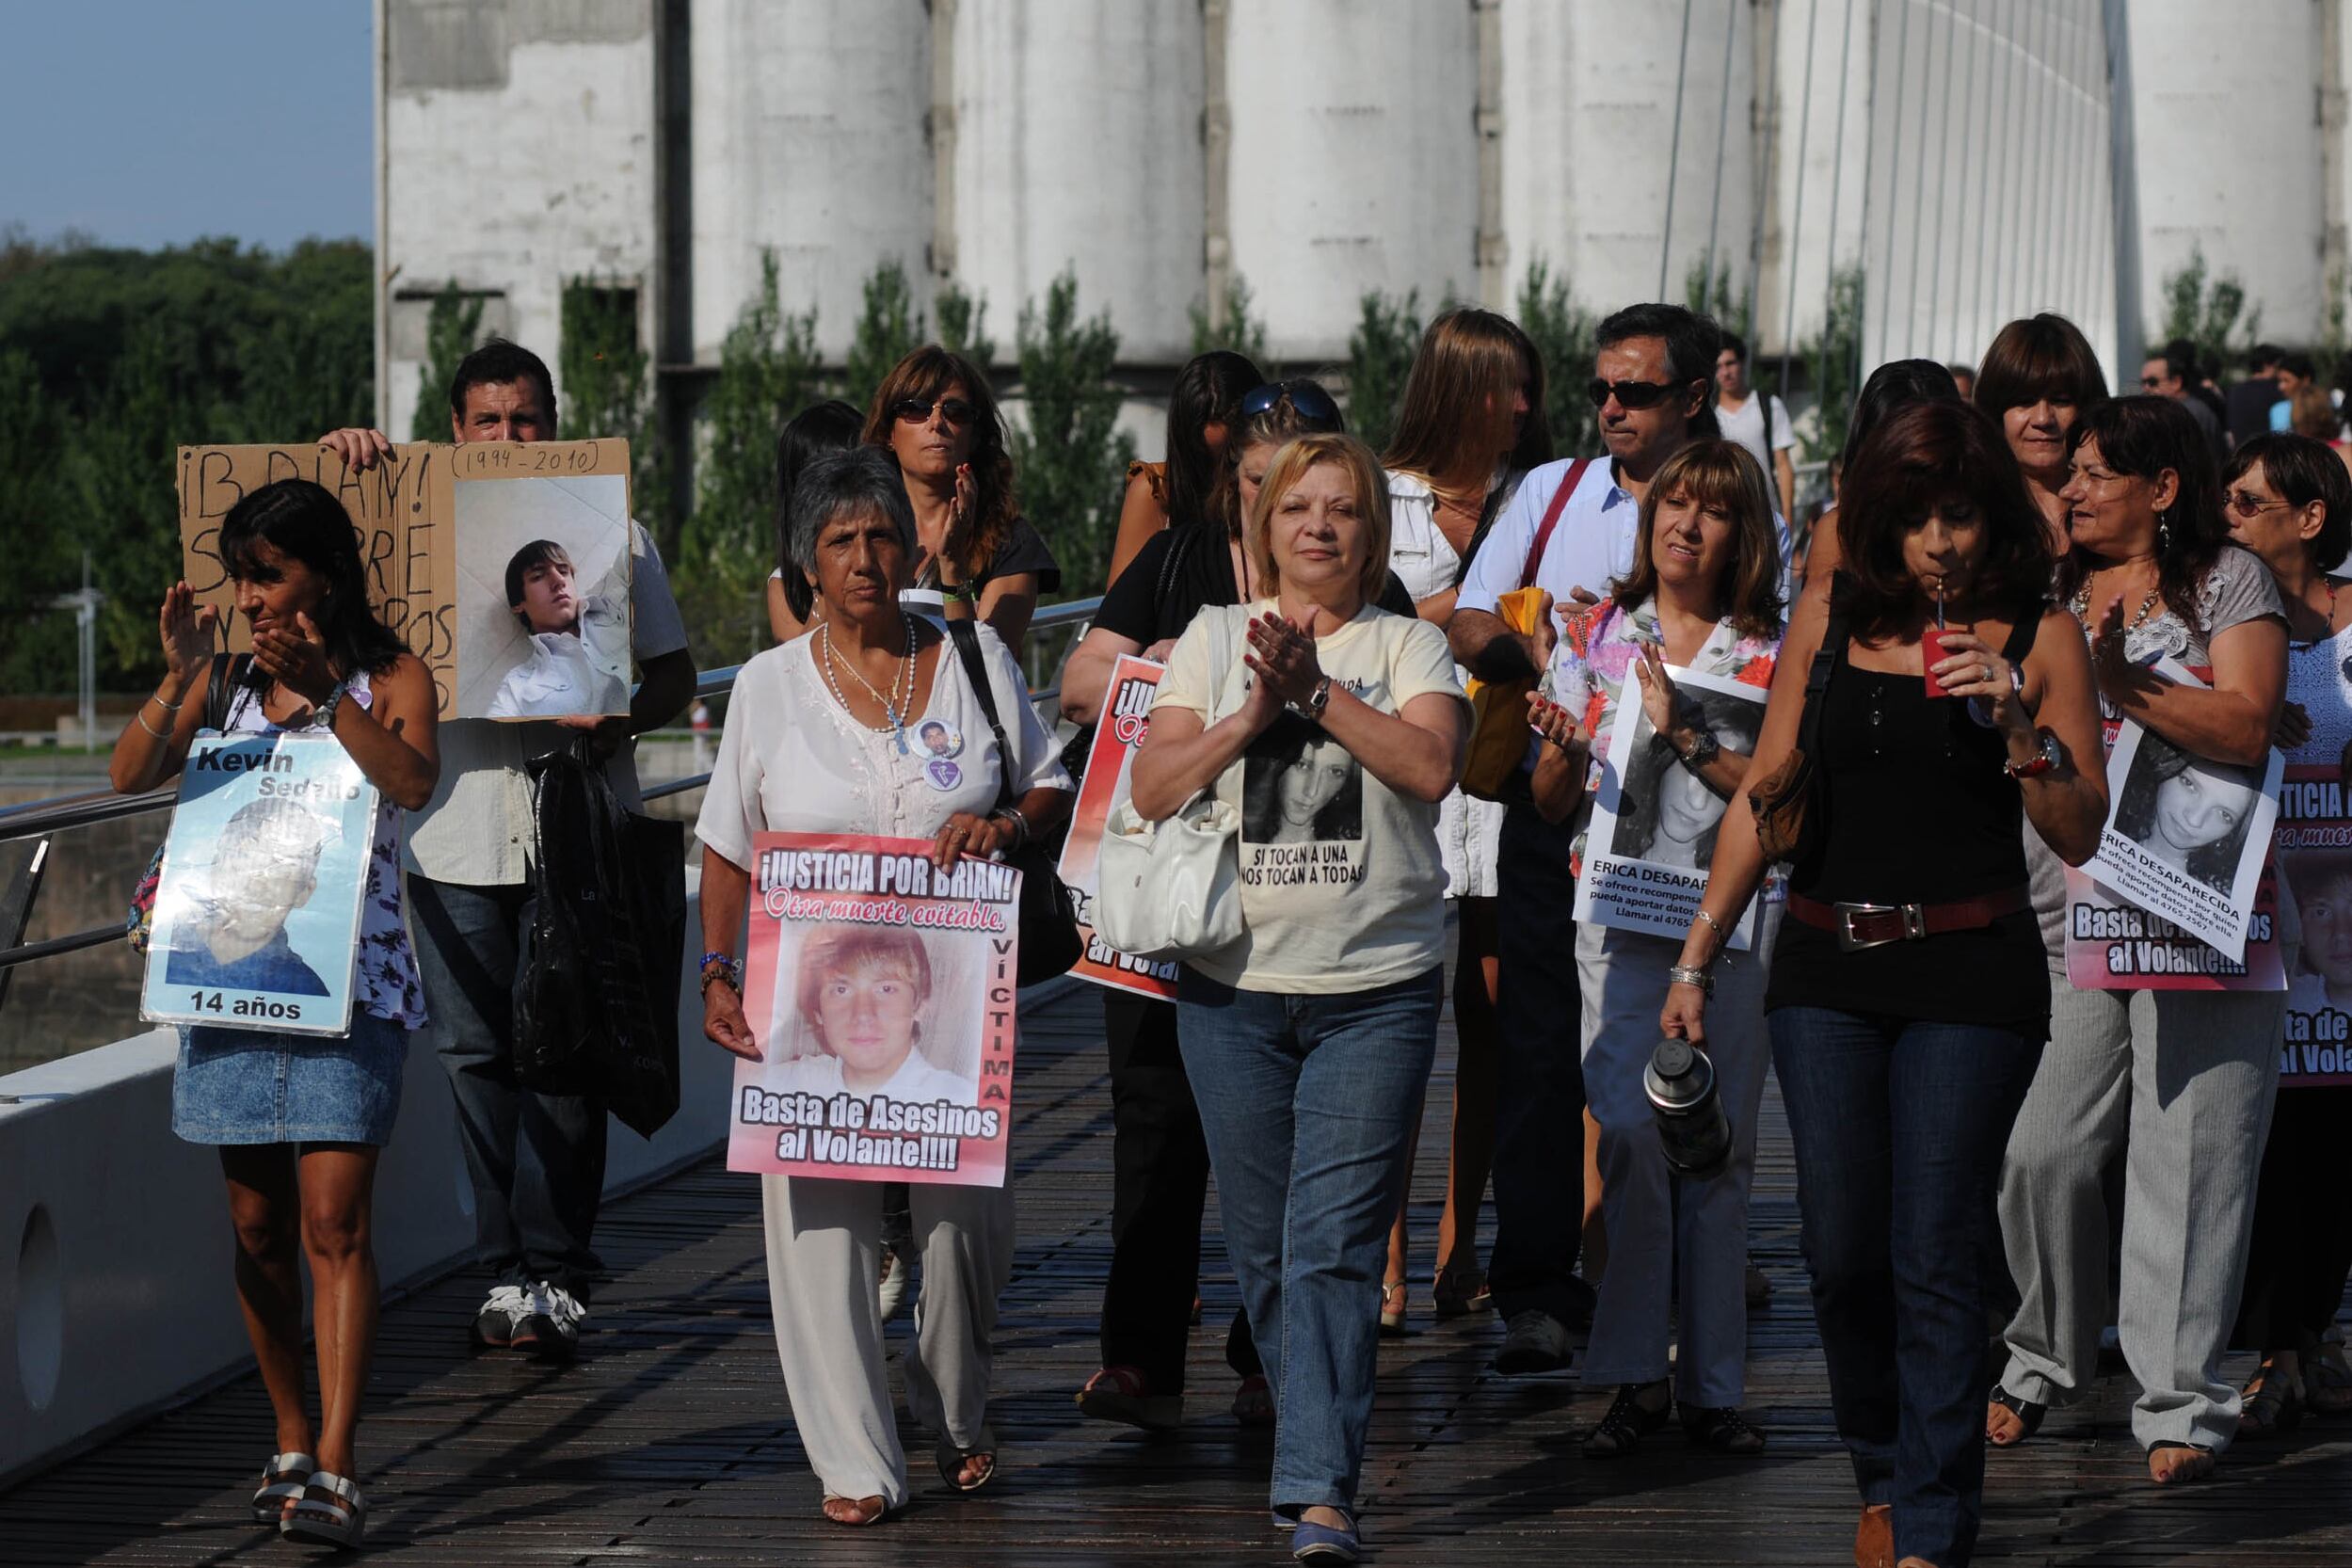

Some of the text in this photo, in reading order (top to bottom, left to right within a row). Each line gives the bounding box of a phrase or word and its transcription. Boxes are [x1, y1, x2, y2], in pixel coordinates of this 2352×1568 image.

[197, 746, 294, 773] Kevin
[1254, 845, 1348, 866] SI TOCAN A UNA
[1592, 859, 1638, 879] ERICA
[760, 850, 1014, 901] ¡JUSTICIA POR BRIAN!
[1240, 864, 1363, 886] NOS TOCAN A TODAS
[1590, 876, 1702, 904] Se ofrece recompensa
[2094, 853, 2124, 874] pueda
[2124, 870, 2160, 894] aportar
[2160, 891, 2187, 910] datos
[2188, 906, 2214, 926] sobre
[2100, 830, 2136, 859] ERICA
[2138, 855, 2241, 921] DESAPARECIDA
[2108, 847, 2136, 872] ofrece
[2137, 868, 2194, 904] recompensa
[2195, 903, 2212, 915] por
[2212, 910, 2239, 932] quien
[2117, 875, 2150, 898] Llamar
[2150, 895, 2160, 905] al
[765, 886, 1006, 931] Otra muerte evitable.
[1590, 890, 1695, 916] pueda aportar datos
[1615, 906, 1651, 921] Llamar
[1653, 913, 1663, 923] al
[2075, 905, 2144, 938] Basta
[2108, 941, 2134, 973] al
[191, 991, 301, 1019] 14 años
[983, 939, 1014, 1099] VÍCTIMA
[2316, 1010, 2348, 1041] de
[742, 1088, 1000, 1138] Basta de Asesinos
[778, 1129, 958, 1170] al Volante!!!!
